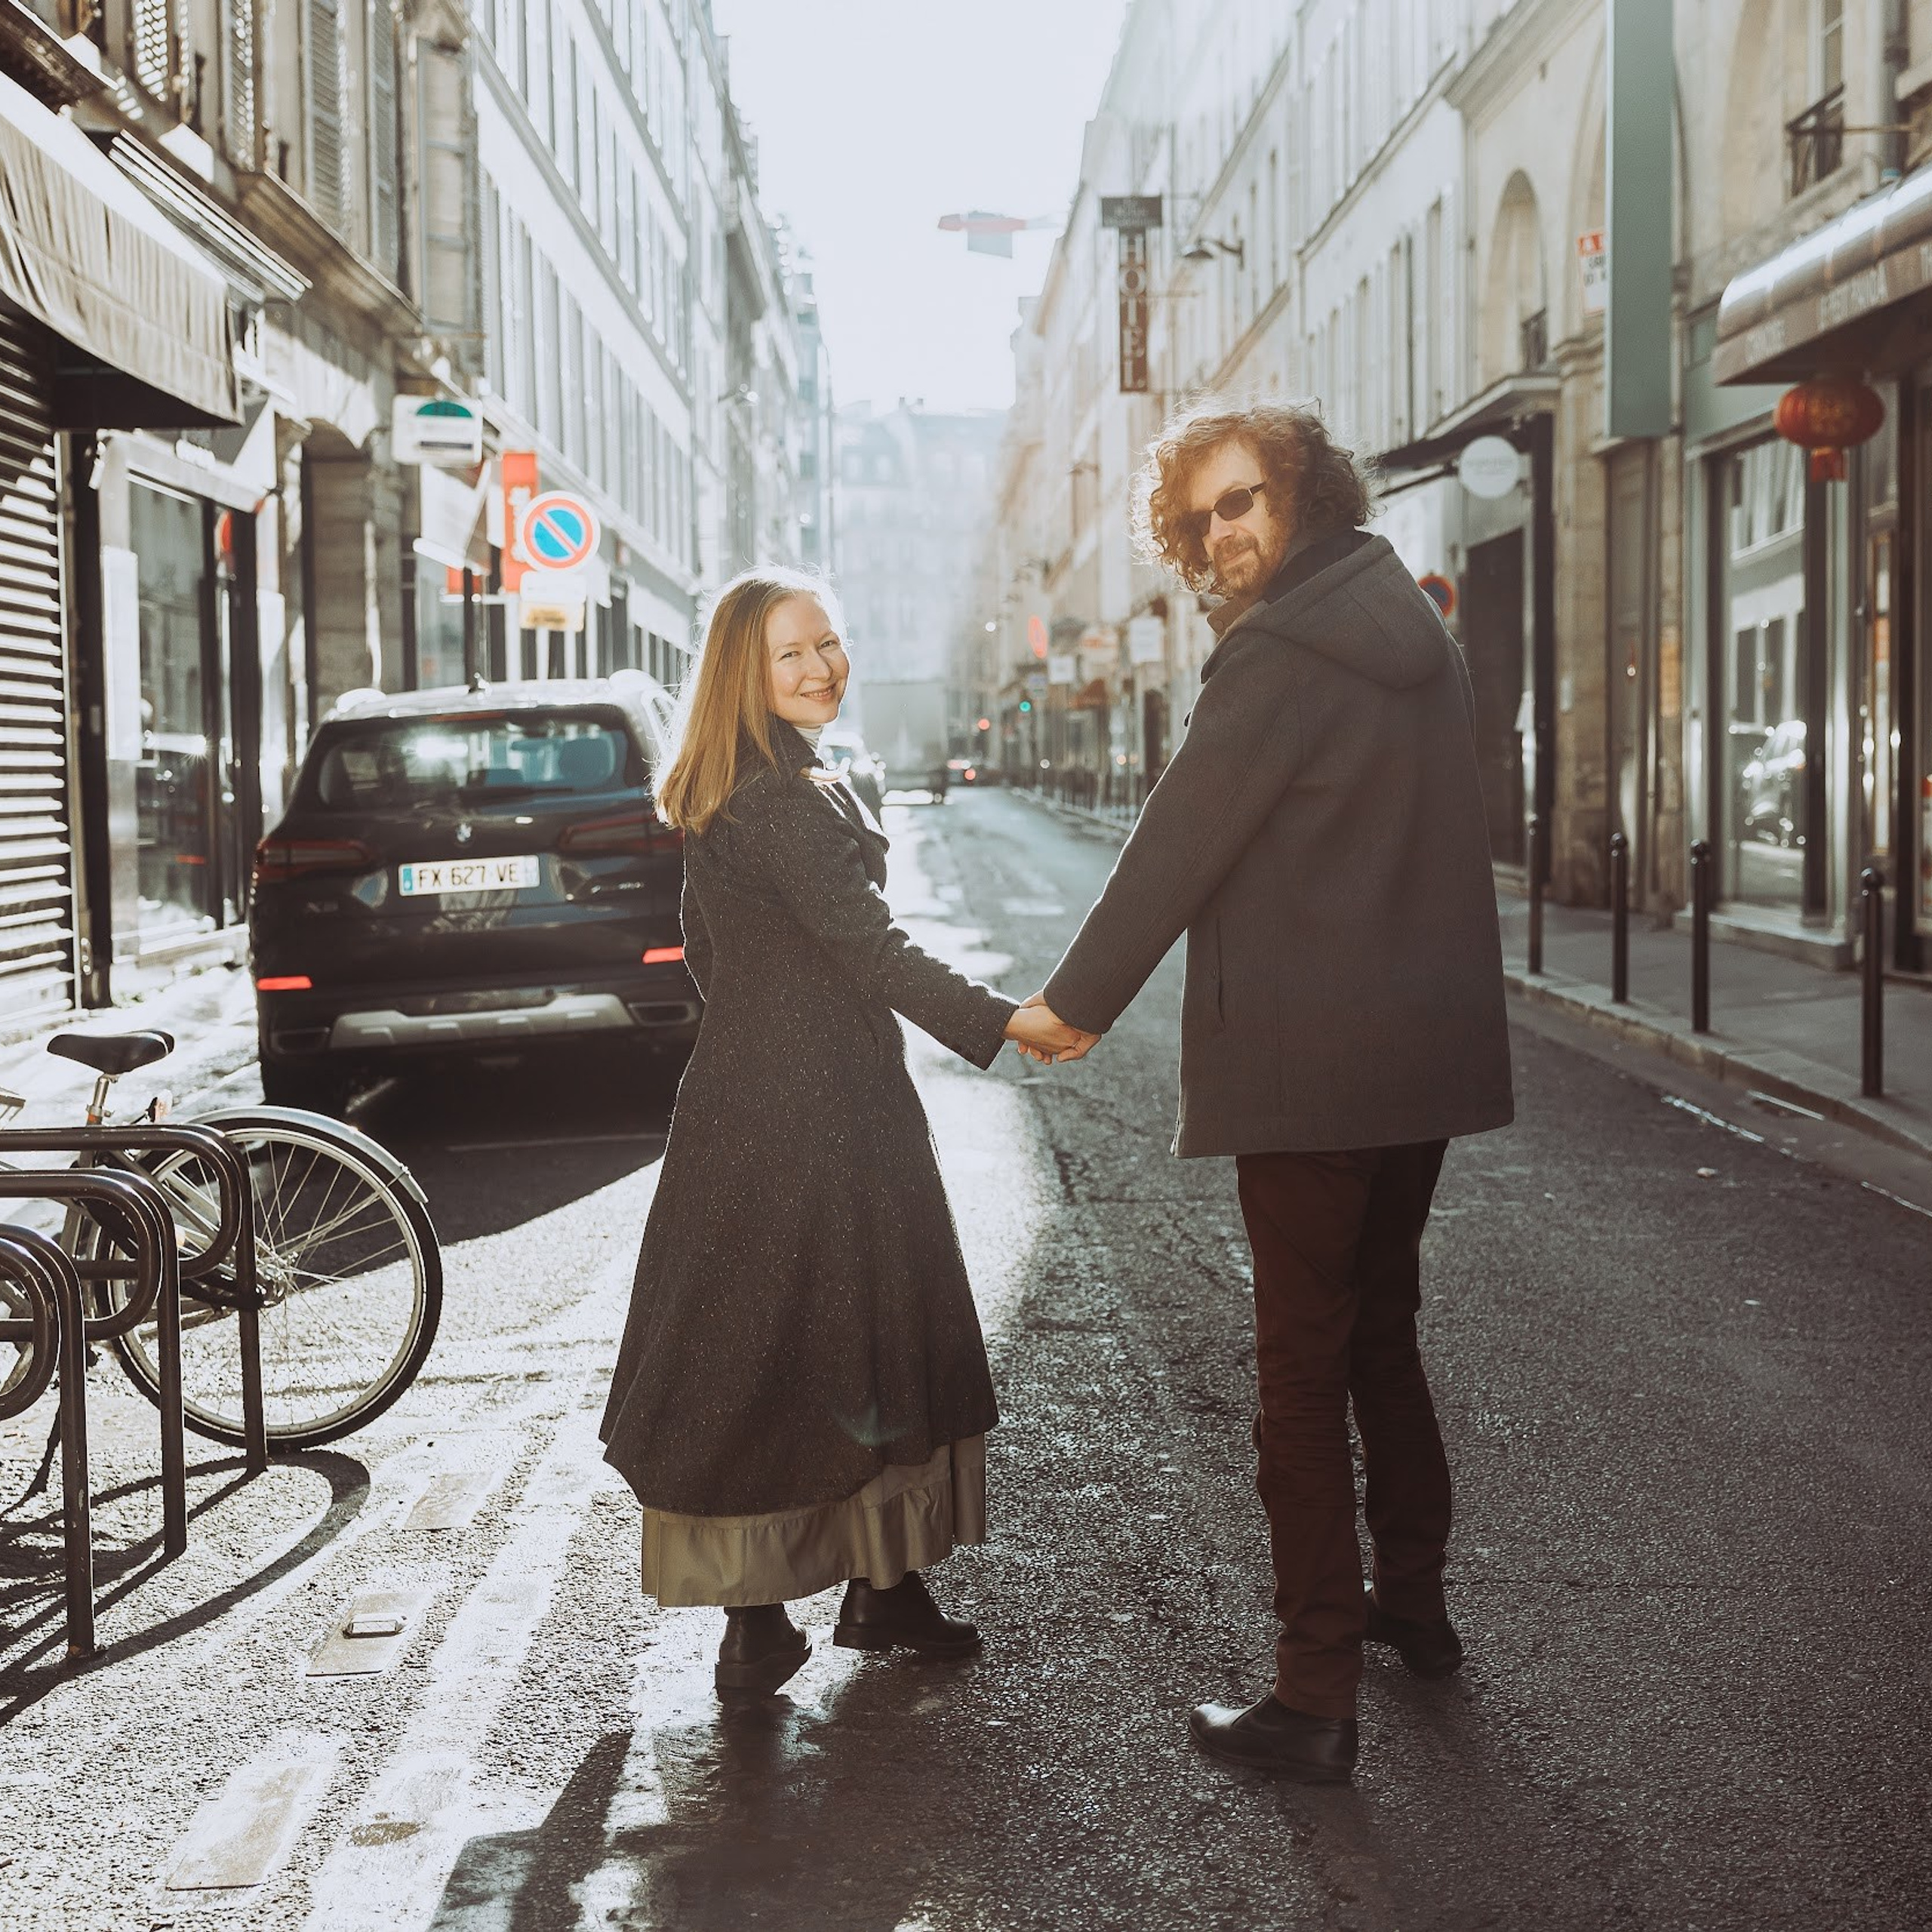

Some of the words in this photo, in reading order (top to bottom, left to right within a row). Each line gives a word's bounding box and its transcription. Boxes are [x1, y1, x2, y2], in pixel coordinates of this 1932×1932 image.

[419, 869, 441, 888] FX
[451, 865, 486, 886] 627
[497, 863, 519, 883] VE
